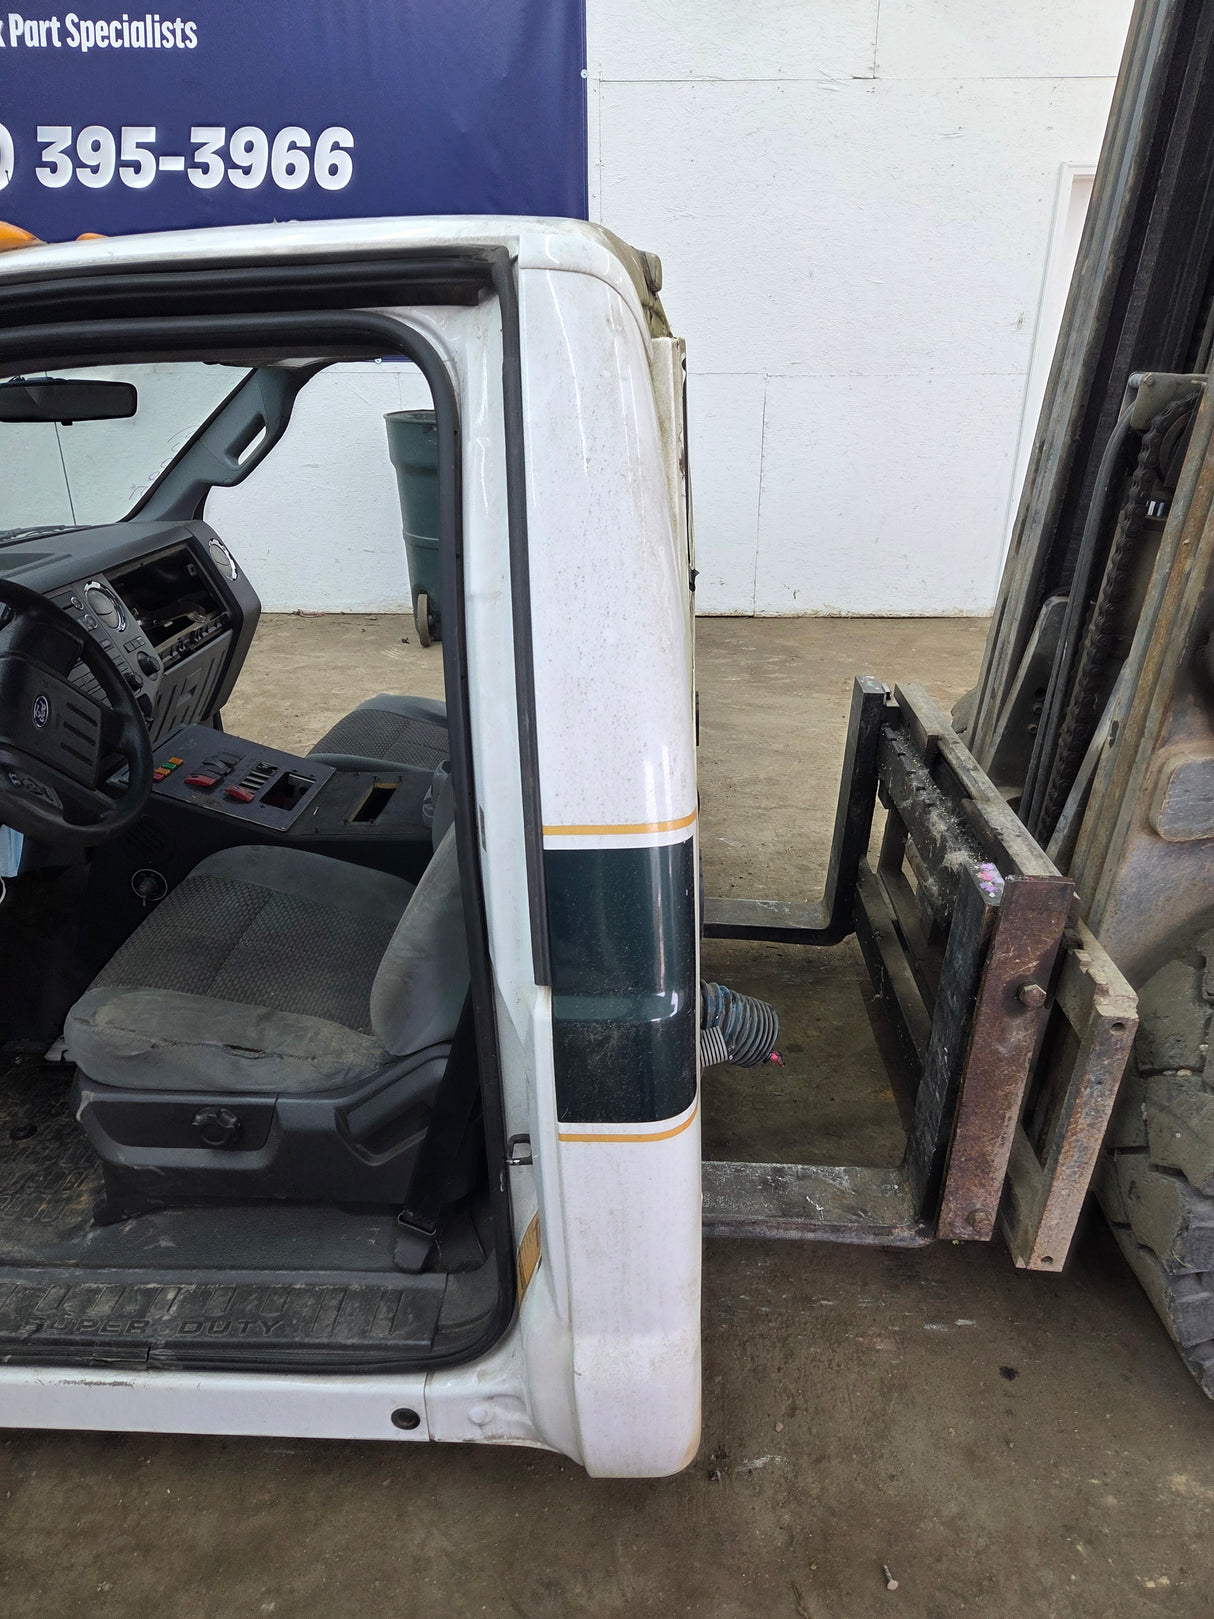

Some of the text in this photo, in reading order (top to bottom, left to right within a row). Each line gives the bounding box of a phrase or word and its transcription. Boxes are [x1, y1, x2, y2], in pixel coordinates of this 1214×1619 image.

[8, 13, 62, 48] Part
[65, 13, 198, 52] Specialists
[35, 125, 355, 190] 395-3966
[176, 1319, 285, 1337] DUTY
